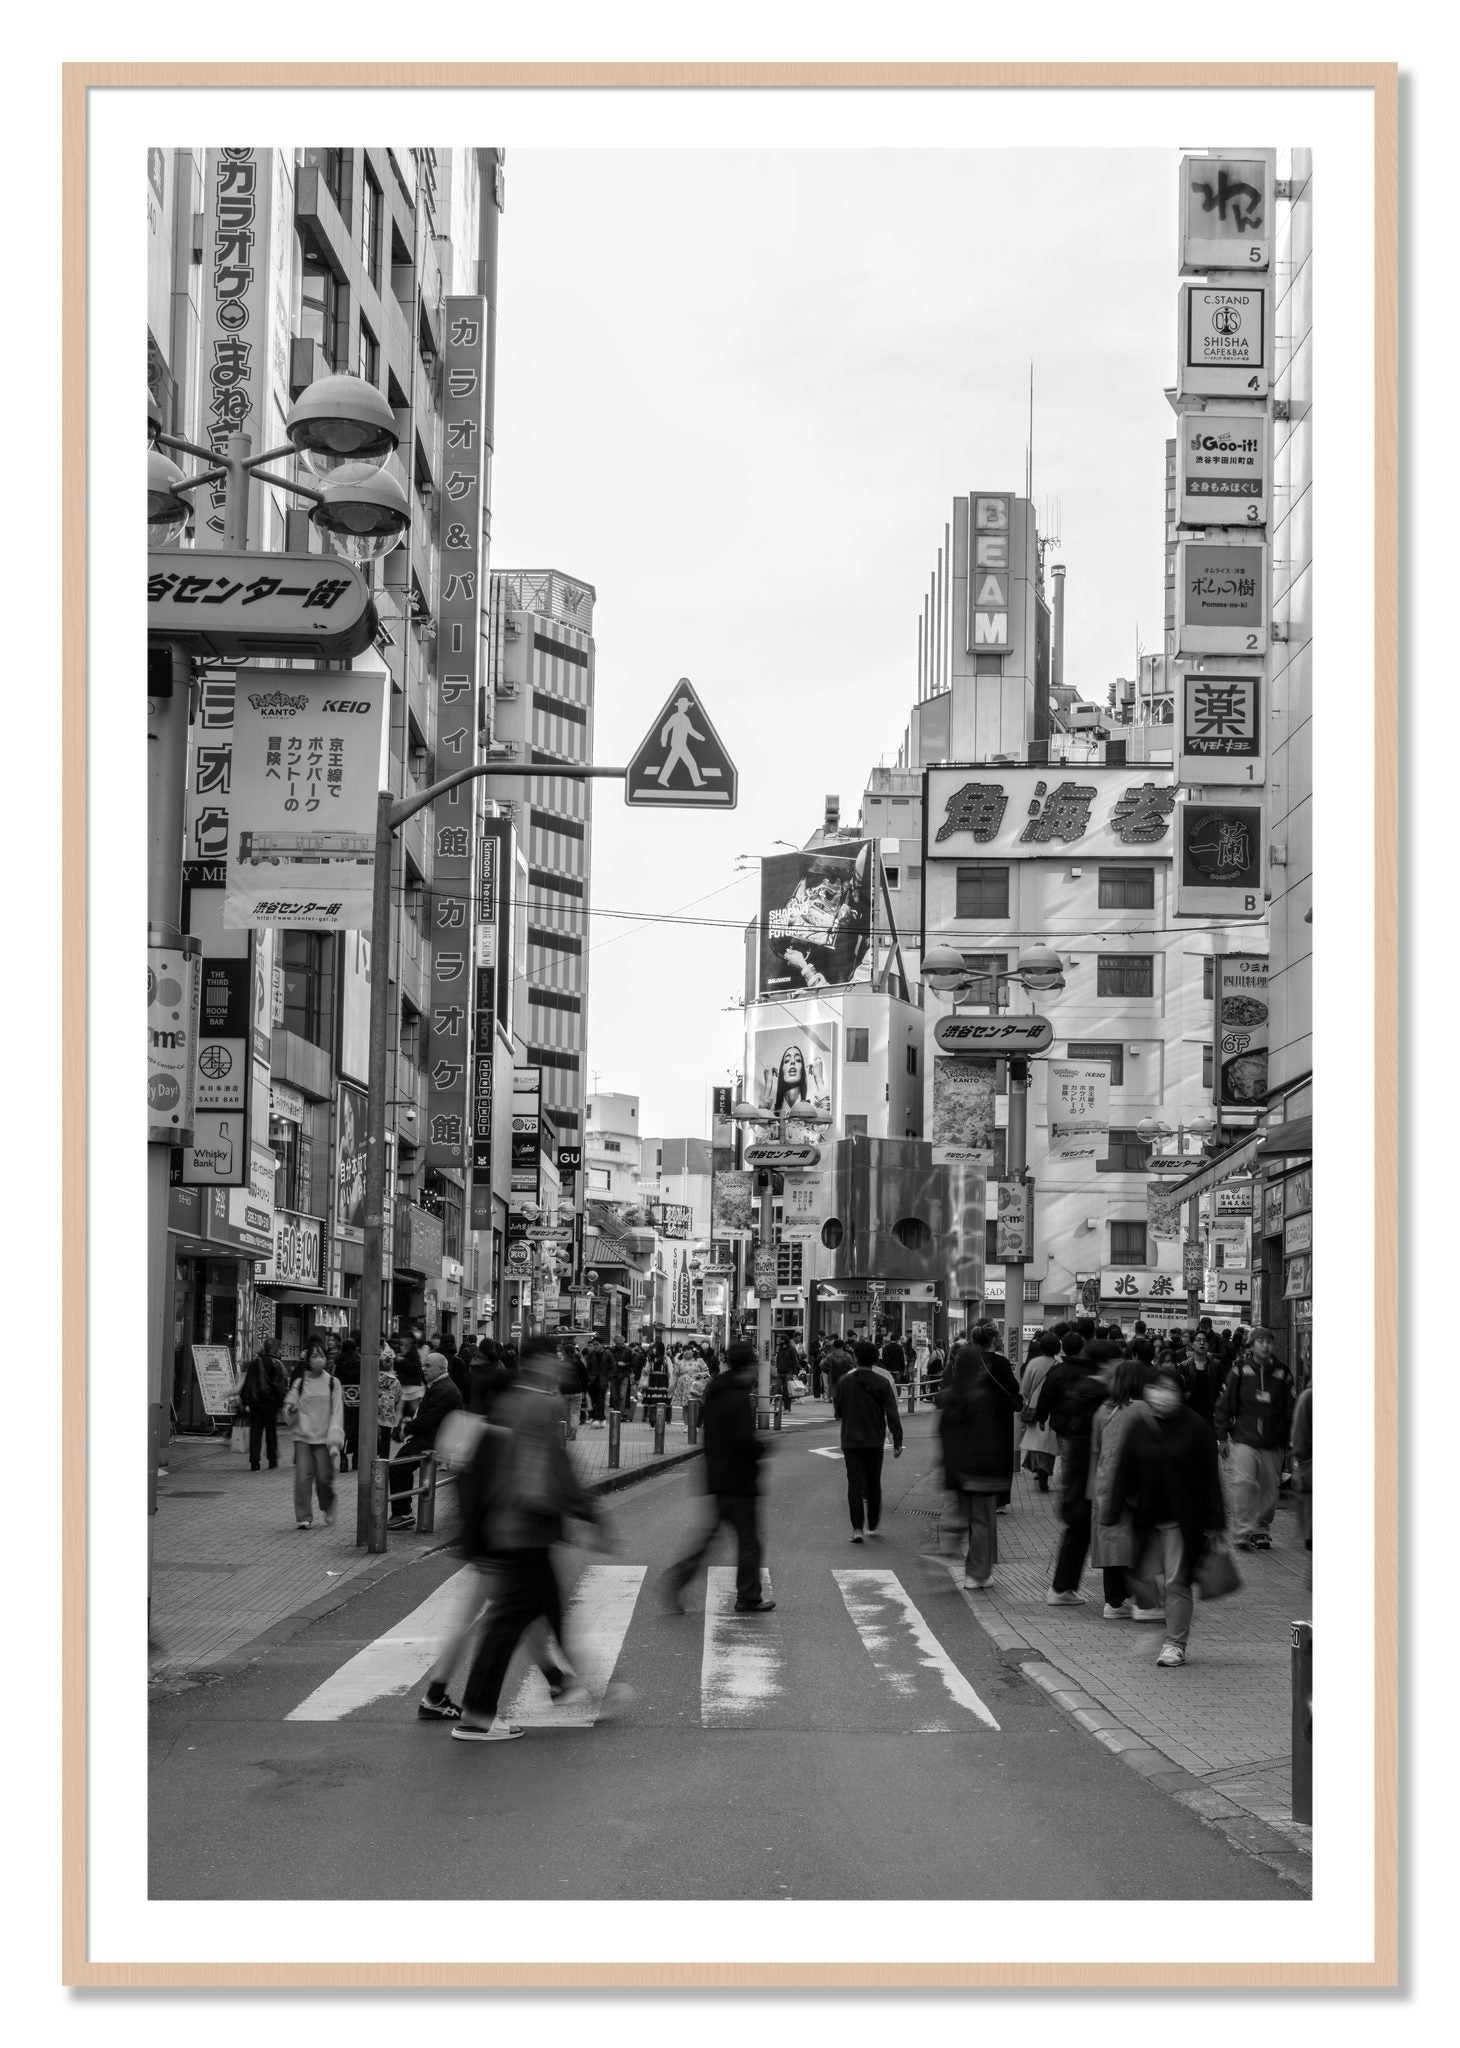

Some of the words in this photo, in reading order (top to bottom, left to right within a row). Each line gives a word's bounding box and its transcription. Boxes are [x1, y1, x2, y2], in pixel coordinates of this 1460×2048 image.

[213, 160, 257, 300] カラオケ
[1249, 247, 1261, 262] 5
[1204, 295, 1250, 305] C.STAND
[1204, 336, 1249, 347] SHISHA
[1203, 348, 1249, 356] CAFE&BAR
[1247, 375, 1260, 391] 4
[1202, 436, 1258, 452] Goo-it!
[1195, 456, 1254, 465] 渋谷宇田川町店
[1190, 482, 1259, 493] 全身もみほぐし
[1246, 504, 1259, 521] 3
[974, 497, 1008, 644] BEAM
[1191, 577, 1256, 597] ポムの樹
[1245, 633, 1258, 650] 2
[260, 708, 297, 716] KANTO
[322, 700, 372, 714] KEIO
[1194, 683, 1246, 735] 薬
[1188, 738, 1251, 753] マツモトキヨシ
[265, 736, 282, 780] 冒険へ
[284, 736, 303, 812] カントーの
[305, 736, 324, 813] ポケパーク
[327, 738, 345, 798] 京王線で
[1245, 764, 1254, 780] 1
[935, 781, 1180, 843] 角海老
[1188, 821, 1250, 871] 一蘭
[252, 902, 344, 915] 渋谷センター街
[1244, 894, 1256, 911] B
[1223, 975, 1269, 988] 四川料理
[206, 1007, 228, 1015] ROOM
[431, 899, 467, 1146] カラオケ館
[942, 1025, 1046, 1038] 渋谷センター街
[1221, 1033, 1250, 1055] 6F
[158, 1083, 179, 1098] Day!
[524, 1123, 537, 1131] UP
[194, 1149, 228, 1160] Whisky
[559, 1152, 580, 1164] GU
[193, 1159, 214, 1168] Bank
[1114, 1273, 1175, 1296] 兆楽
[680, 1273, 689, 1315] BEER
